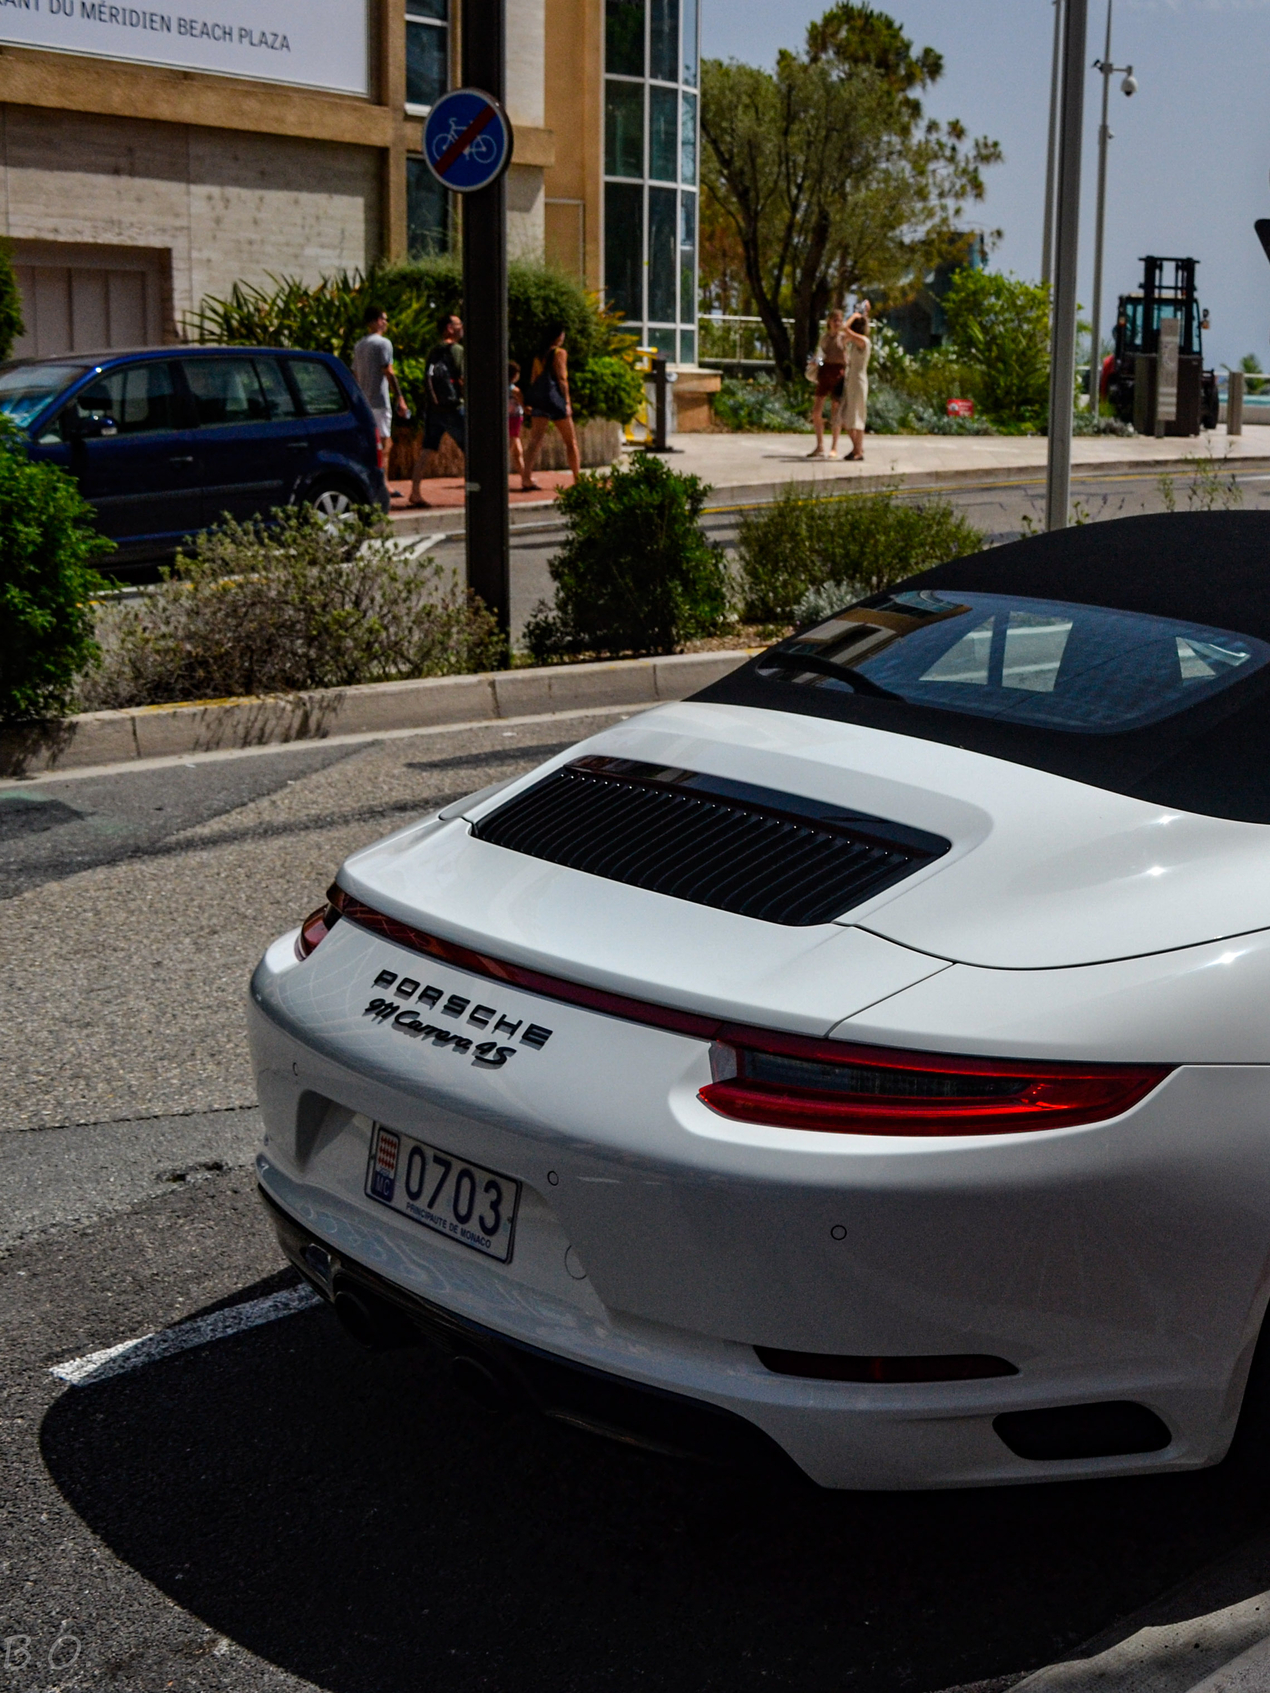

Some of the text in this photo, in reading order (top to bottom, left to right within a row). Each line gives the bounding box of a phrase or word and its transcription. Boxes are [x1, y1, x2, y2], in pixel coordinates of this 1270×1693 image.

[0, 0, 291, 52] ANT DU MÉRIDIEN BEACH PLAZA
[372, 969, 553, 1047] PORSCHE
[394, 1010, 473, 1051] Carrera
[474, 1042, 517, 1065] 4S
[375, 1174, 391, 1196] MC
[405, 1145, 503, 1237] 0703
[448, 1222, 459, 1235] DE
[460, 1227, 492, 1249] MONACO
